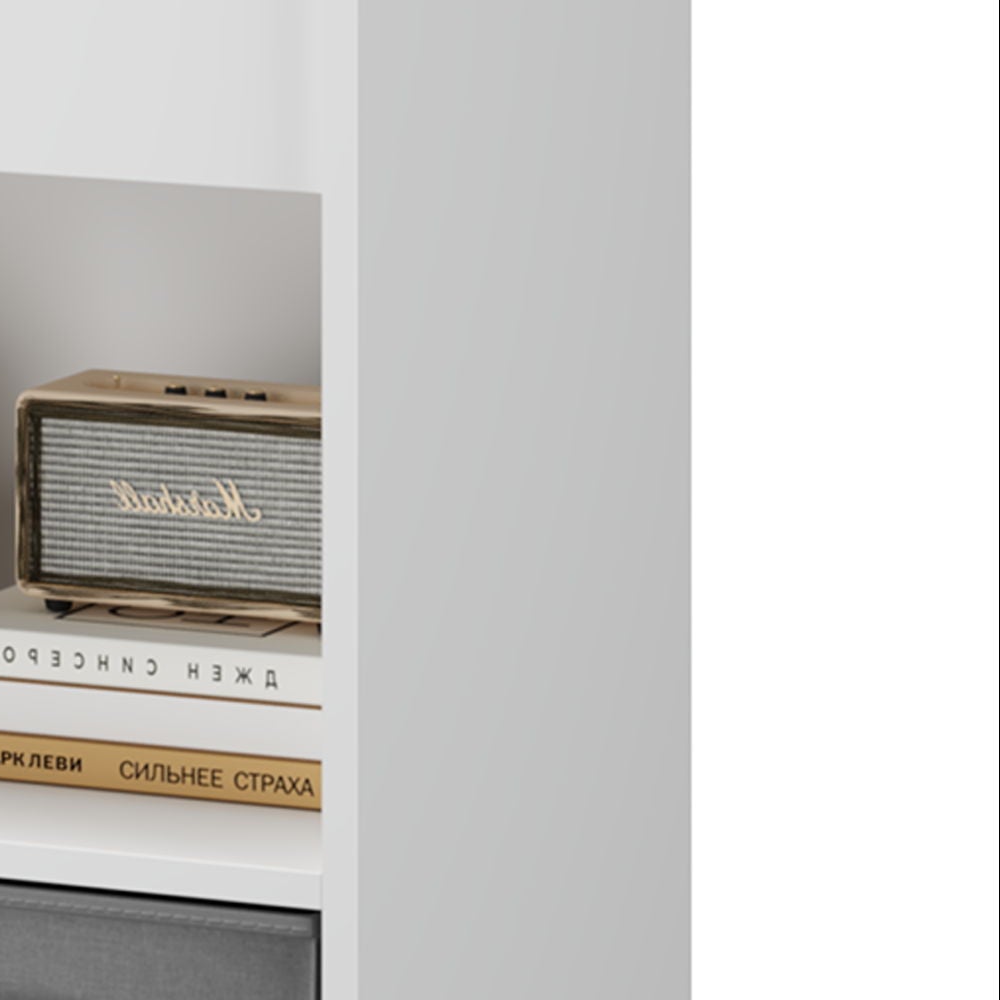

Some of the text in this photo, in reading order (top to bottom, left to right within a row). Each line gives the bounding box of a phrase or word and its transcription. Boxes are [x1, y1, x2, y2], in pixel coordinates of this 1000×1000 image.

[27, 752, 83, 774] ЛЕВИ
[118, 759, 223, 790] СИЛЬНЕЕ
[233, 769, 315, 798] СТРАХА
